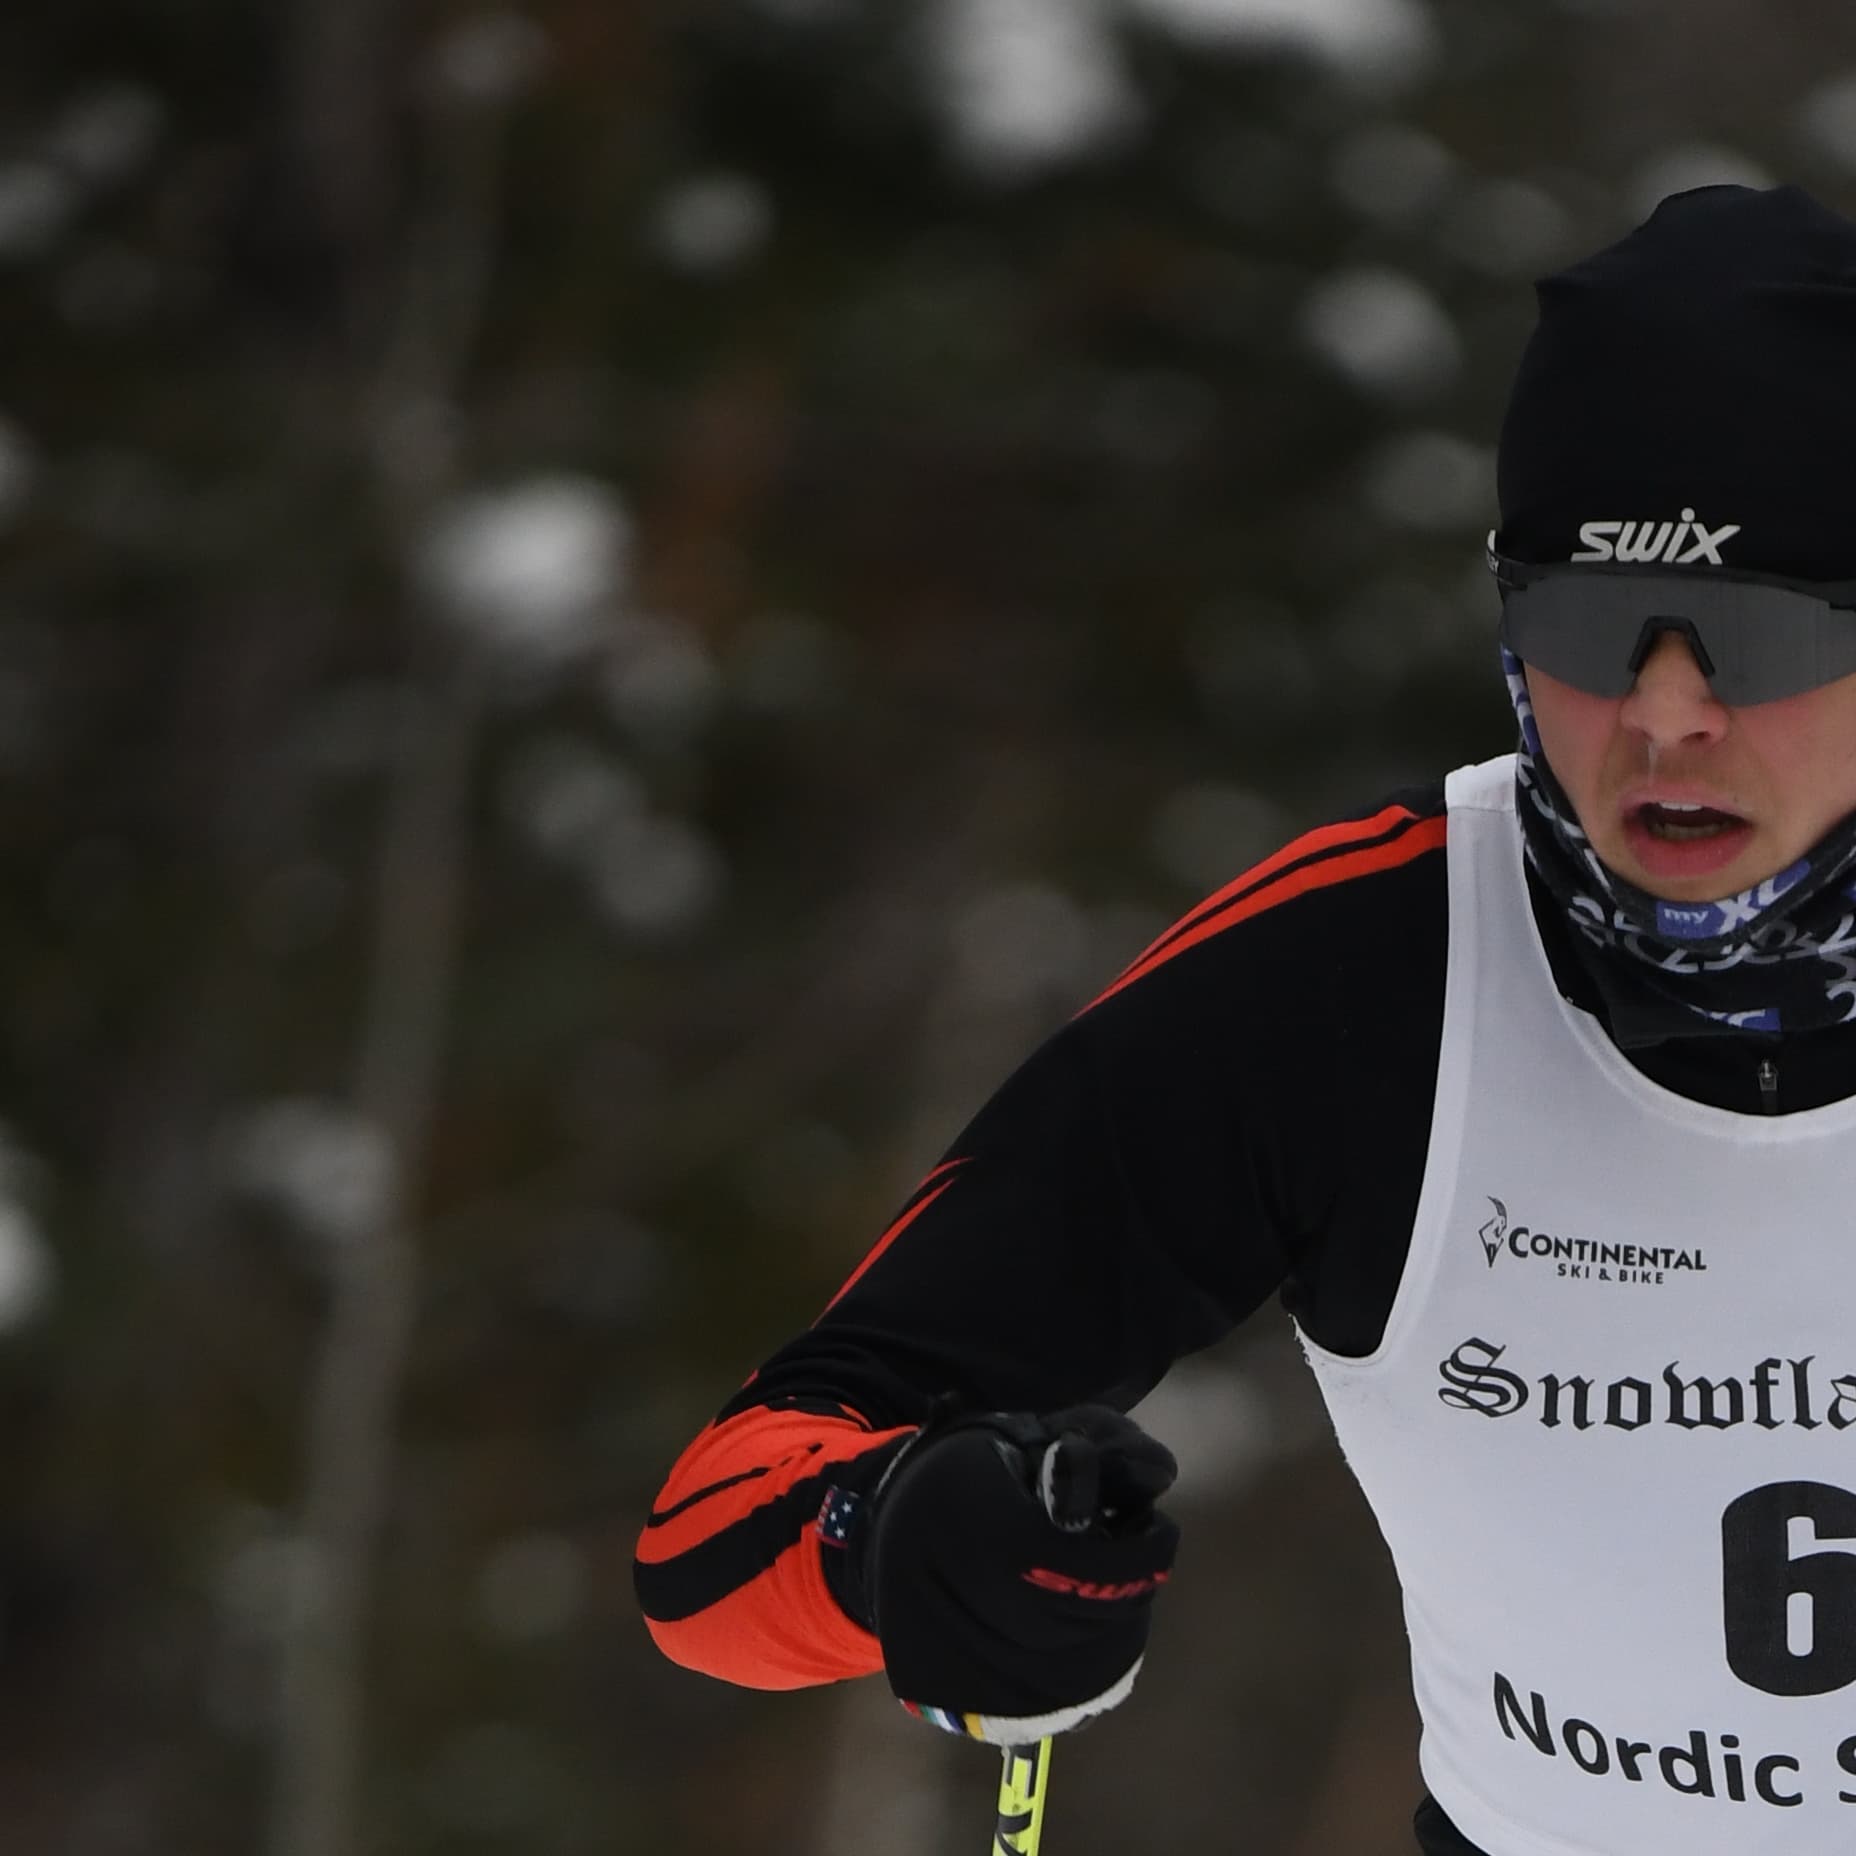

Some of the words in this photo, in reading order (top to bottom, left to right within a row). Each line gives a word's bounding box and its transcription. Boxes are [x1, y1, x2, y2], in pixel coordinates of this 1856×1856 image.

[1508, 1226, 1708, 1272] CONTINENTAL
[1556, 1263, 1591, 1280] SKI
[1598, 1269, 1613, 1283] &
[1618, 1269, 1665, 1286] BIKE
[1494, 1671, 1804, 1807] Nordic
